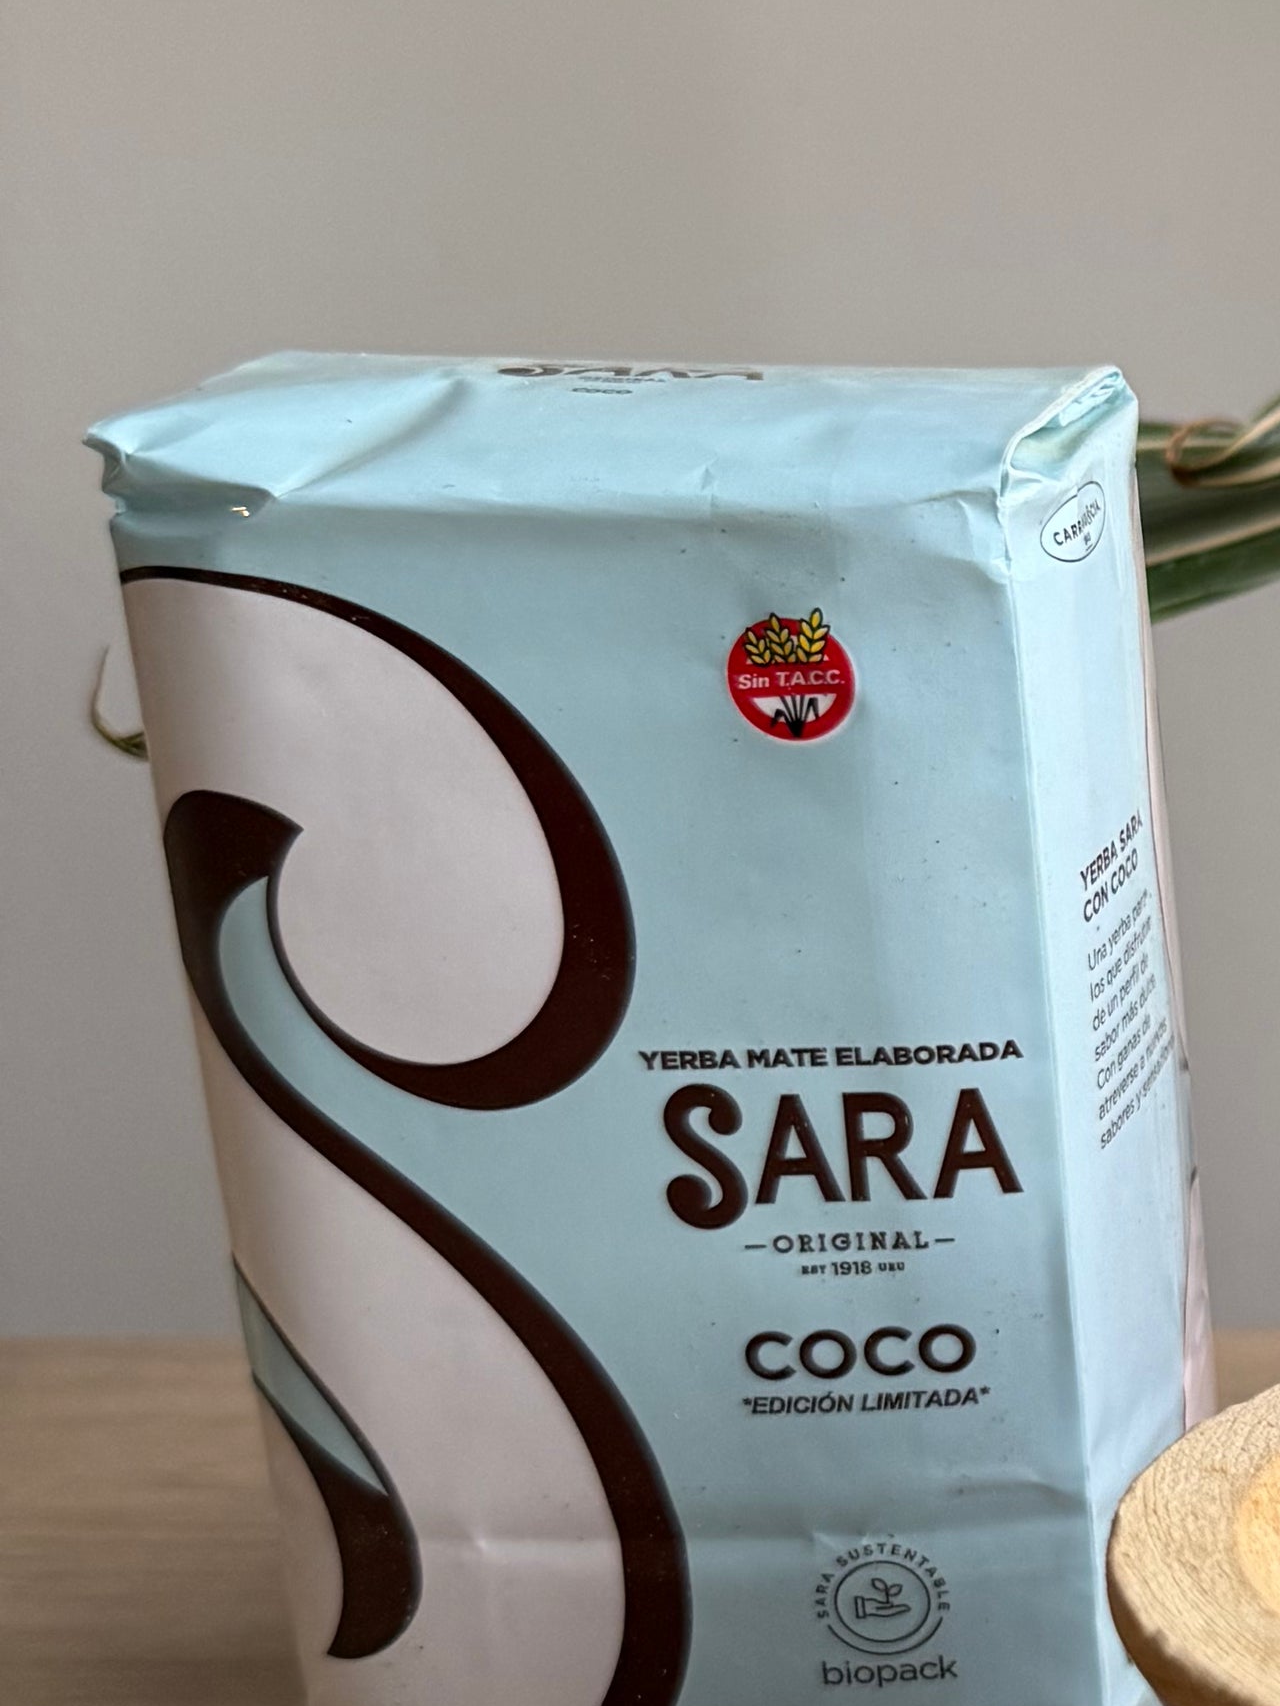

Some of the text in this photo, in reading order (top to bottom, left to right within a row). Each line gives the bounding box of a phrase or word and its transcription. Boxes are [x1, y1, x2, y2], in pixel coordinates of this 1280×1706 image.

[738, 669, 846, 689] Sin T.A.C.C.
[1079, 809, 1143, 892] YERBA SARA
[1083, 848, 1138, 923] CON COCO
[1088, 943, 1107, 971] Una
[1108, 914, 1131, 956] yerba
[1089, 977, 1105, 1002] los
[1106, 958, 1122, 988] que
[1093, 1008, 1106, 1031] de
[1107, 994, 1118, 1017] un
[639, 1039, 1024, 1070] YERBA MATE ELABORADA
[1095, 1022, 1120, 1062] sabor
[1097, 1060, 1116, 1089] Con
[1100, 1098, 1135, 1150] sabores
[663, 1083, 1025, 1230] SARA
[772, 1230, 929, 1254] ORIGINAL
[831, 1261, 872, 1275] 1918
[745, 1323, 977, 1381] COCO
[815, 1543, 951, 1620] SARA SUSTENTABLE
[822, 1655, 958, 1688] biopack
